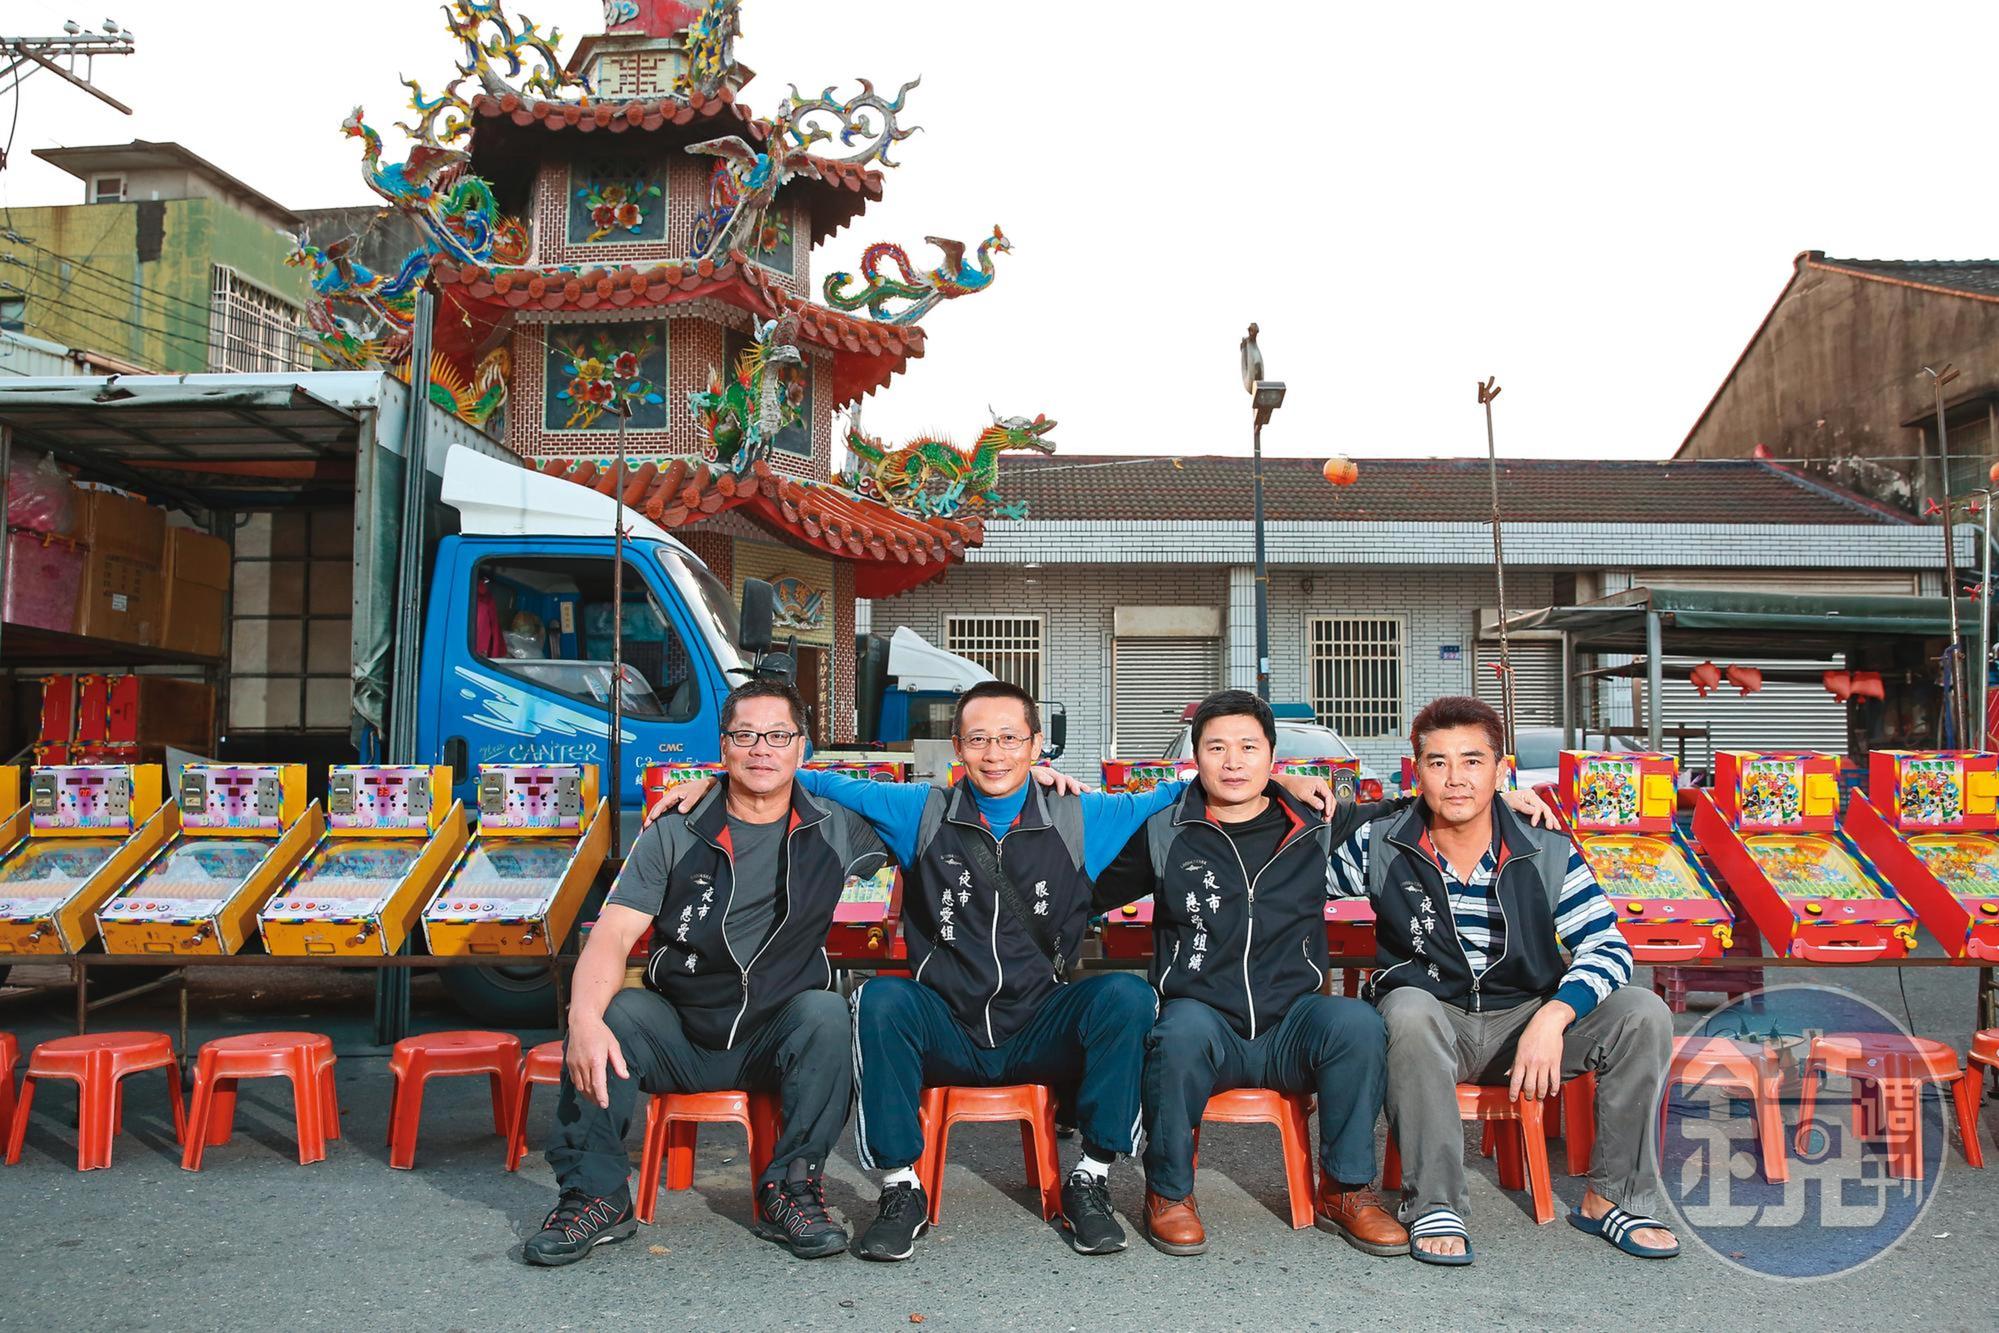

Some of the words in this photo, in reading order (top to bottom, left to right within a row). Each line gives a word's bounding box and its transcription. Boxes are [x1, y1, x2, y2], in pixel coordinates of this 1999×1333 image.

[658, 743, 684, 752] CMC
[697, 886, 714, 920] 夜市
[957, 869, 973, 907] 夜市
[1033, 880, 1050, 916] 眼鏡
[1203, 870, 1221, 914] 夜市
[1420, 895, 1436, 935] 夜市
